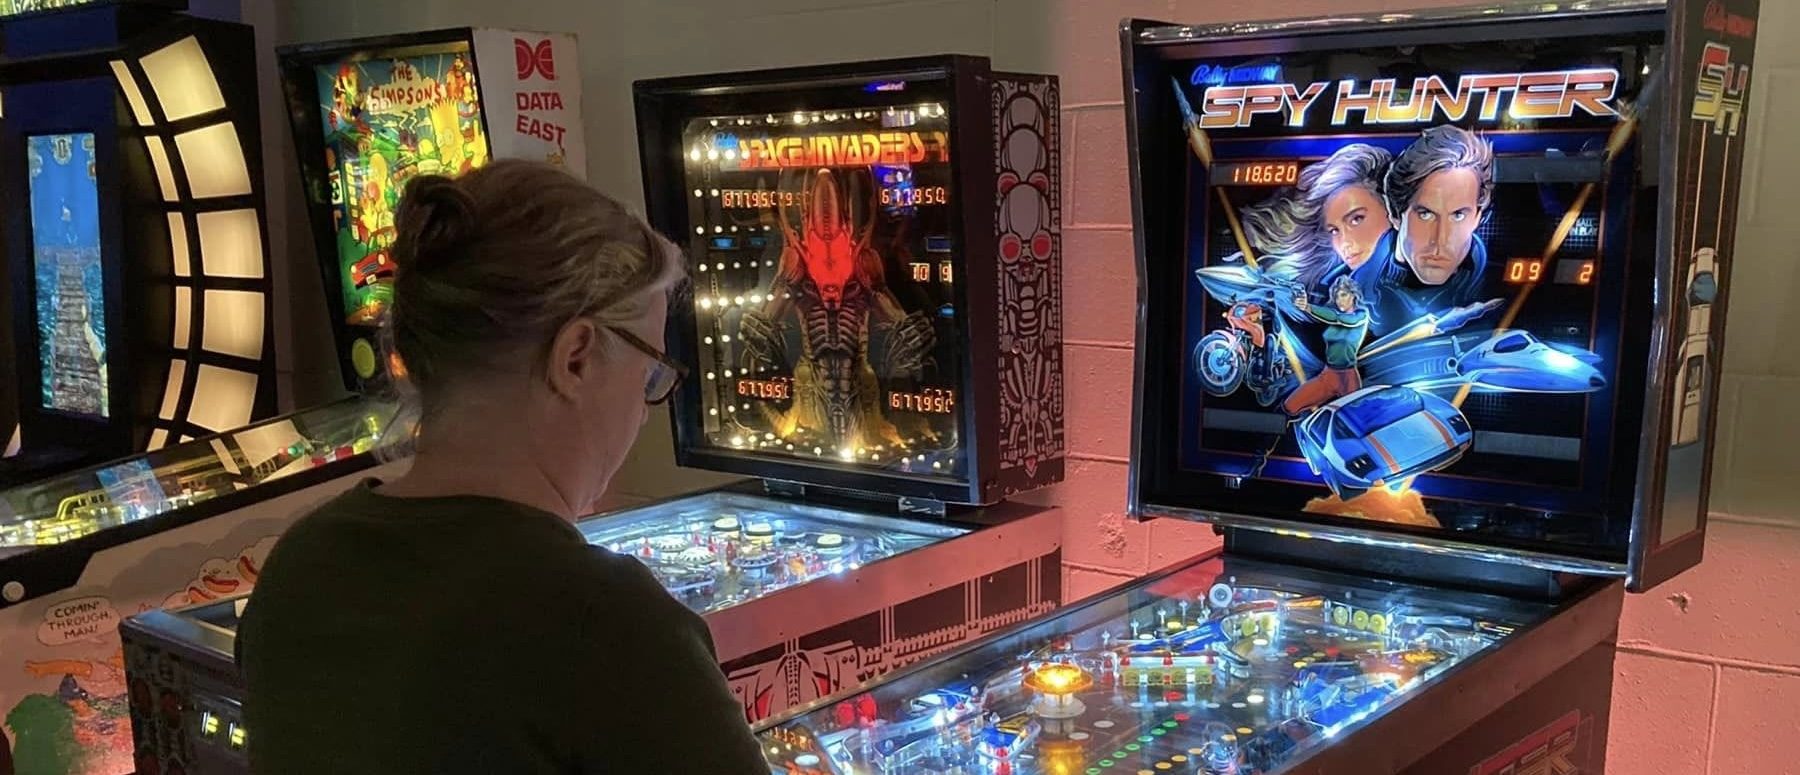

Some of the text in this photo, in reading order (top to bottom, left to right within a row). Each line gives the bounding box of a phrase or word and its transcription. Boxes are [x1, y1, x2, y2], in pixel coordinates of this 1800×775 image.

[391, 63, 413, 84] THE
[370, 80, 441, 106] SIMPSONS
[516, 92, 563, 111] DATA
[1200, 69, 1620, 128] SPY HUNTER
[516, 114, 566, 145] EAST
[738, 137, 803, 168] SPACE
[804, 131, 926, 166] INVADERS
[1511, 262, 1541, 281] 09
[1580, 264, 1593, 283] 2
[63, 624, 98, 639] MAN!
